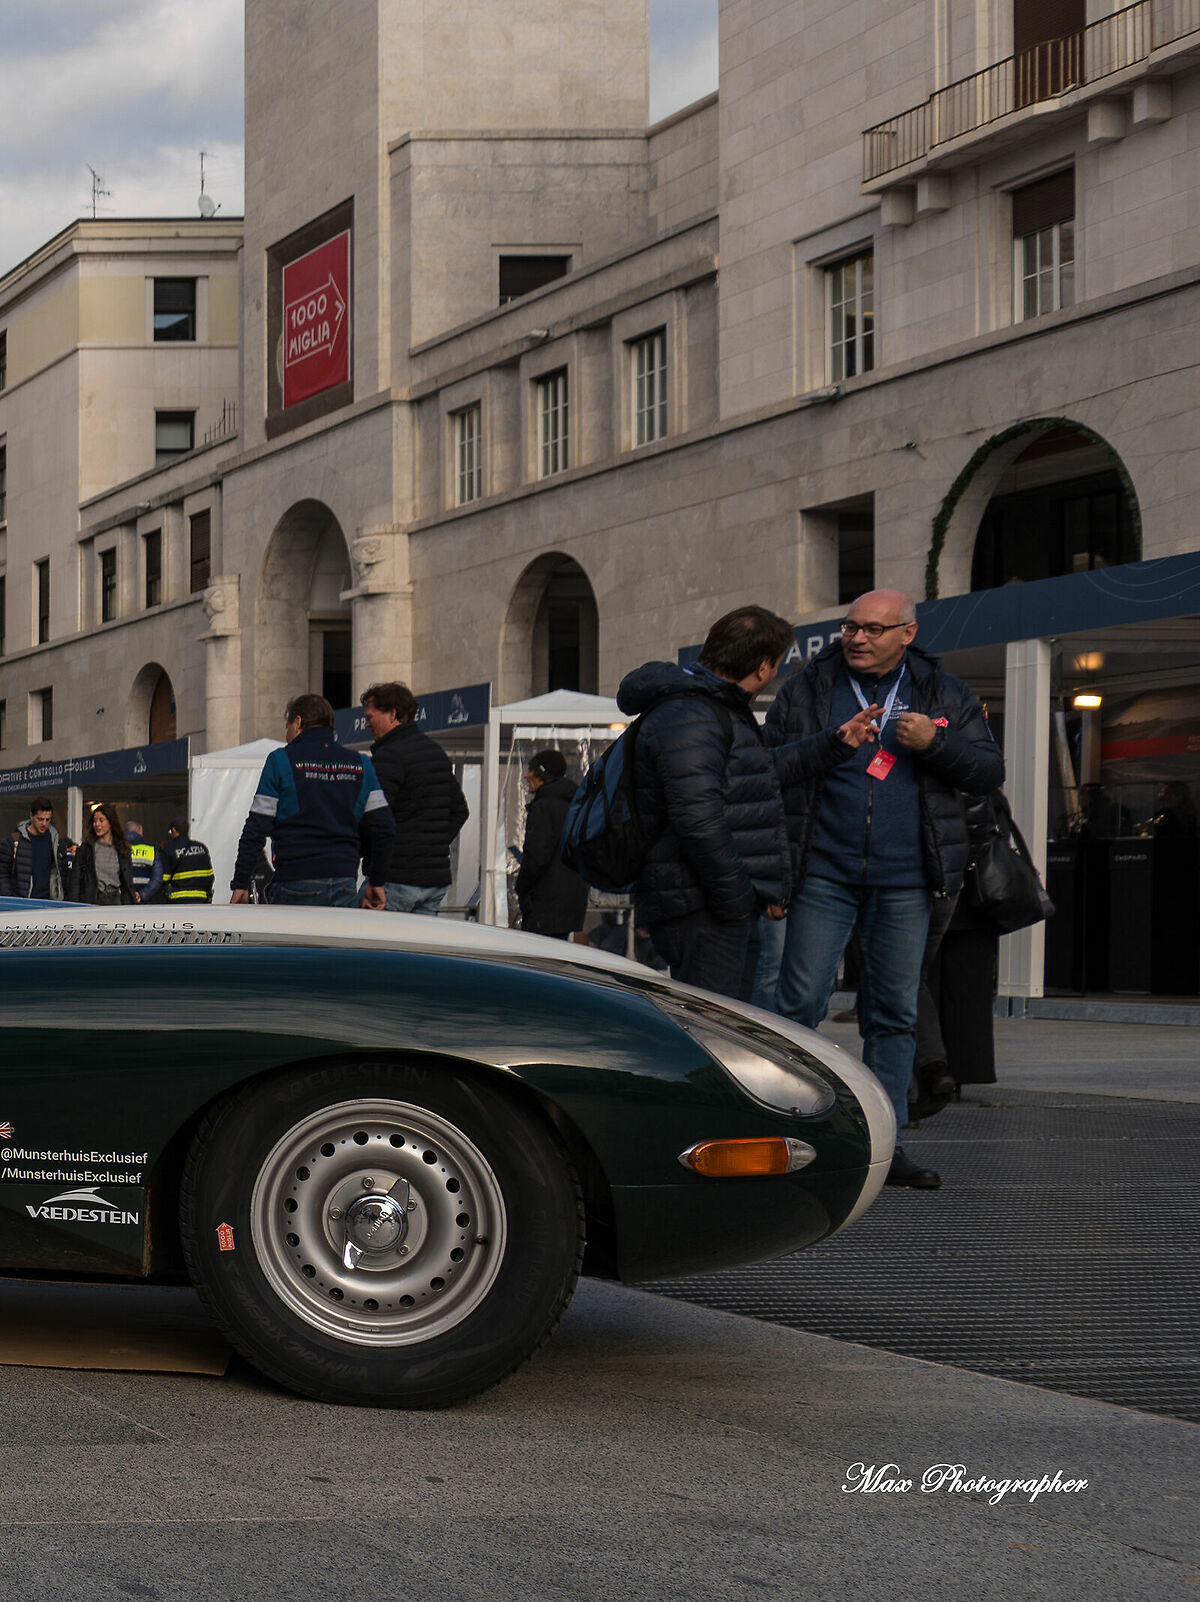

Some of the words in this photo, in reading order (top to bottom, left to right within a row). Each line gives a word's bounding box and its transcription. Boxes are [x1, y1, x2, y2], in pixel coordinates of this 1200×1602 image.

[291, 294, 328, 329] 1000
[289, 320, 330, 358] MIGLIA
[354, 718, 366, 731] PR
[414, 707, 427, 721] EA
[29, 764, 63, 779] CONTROLLO
[64, 759, 96, 772] POLIZIA
[130, 848, 148, 857] AFF
[5, 922, 195, 930] MUNSTERHUIS
[0, 1148, 148, 1165] @MunsterhuisExclusief
[1, 1167, 142, 1184] /MunsterhuisExclusief
[25, 1205, 139, 1225] VREDESTEIN
